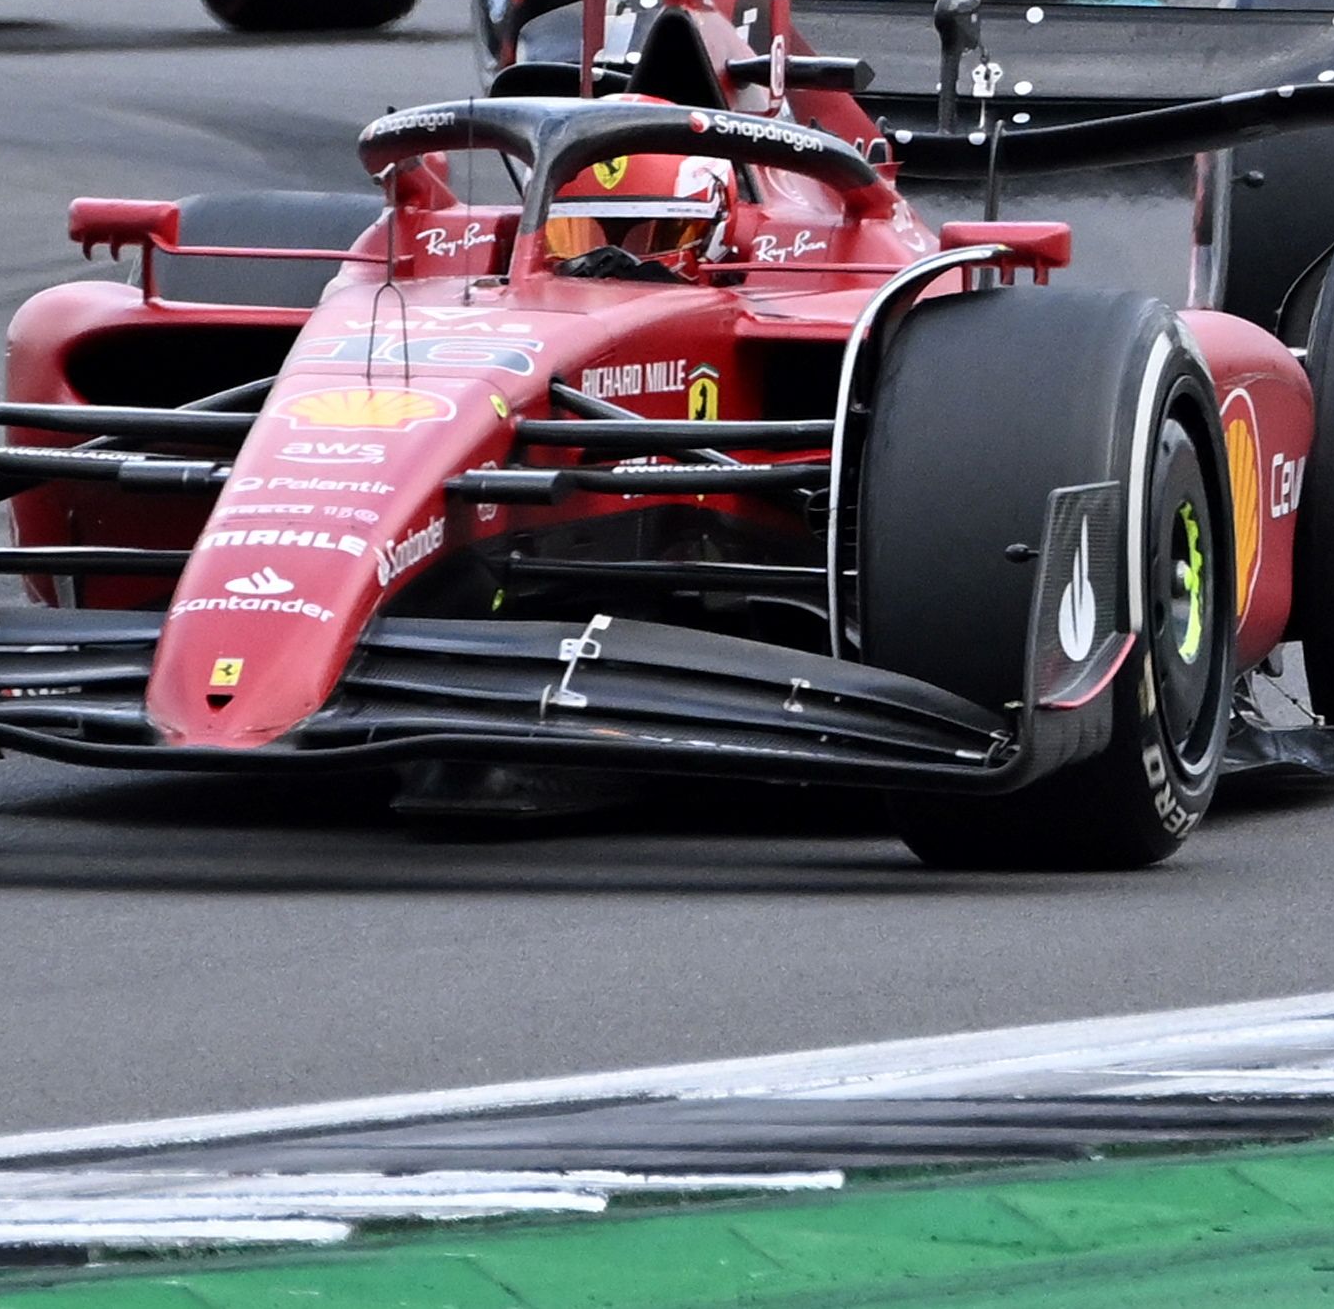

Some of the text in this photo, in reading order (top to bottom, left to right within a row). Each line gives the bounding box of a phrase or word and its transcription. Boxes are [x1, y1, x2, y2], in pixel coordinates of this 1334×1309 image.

[714, 113, 824, 153] Snapdragon
[416, 223, 496, 257] Ray-Ban
[751, 230, 828, 263] Ray-Ban
[289, 334, 545, 377] 16
[581, 358, 687, 398] RICHARD MILLE
[281, 441, 386, 457] aws
[267, 476, 396, 495] Palantir
[199, 529, 368, 558] MAHLE
[385, 515, 446, 581] Santander
[168, 594, 335, 623] Santander
[1142, 742, 1199, 839] ZERO
